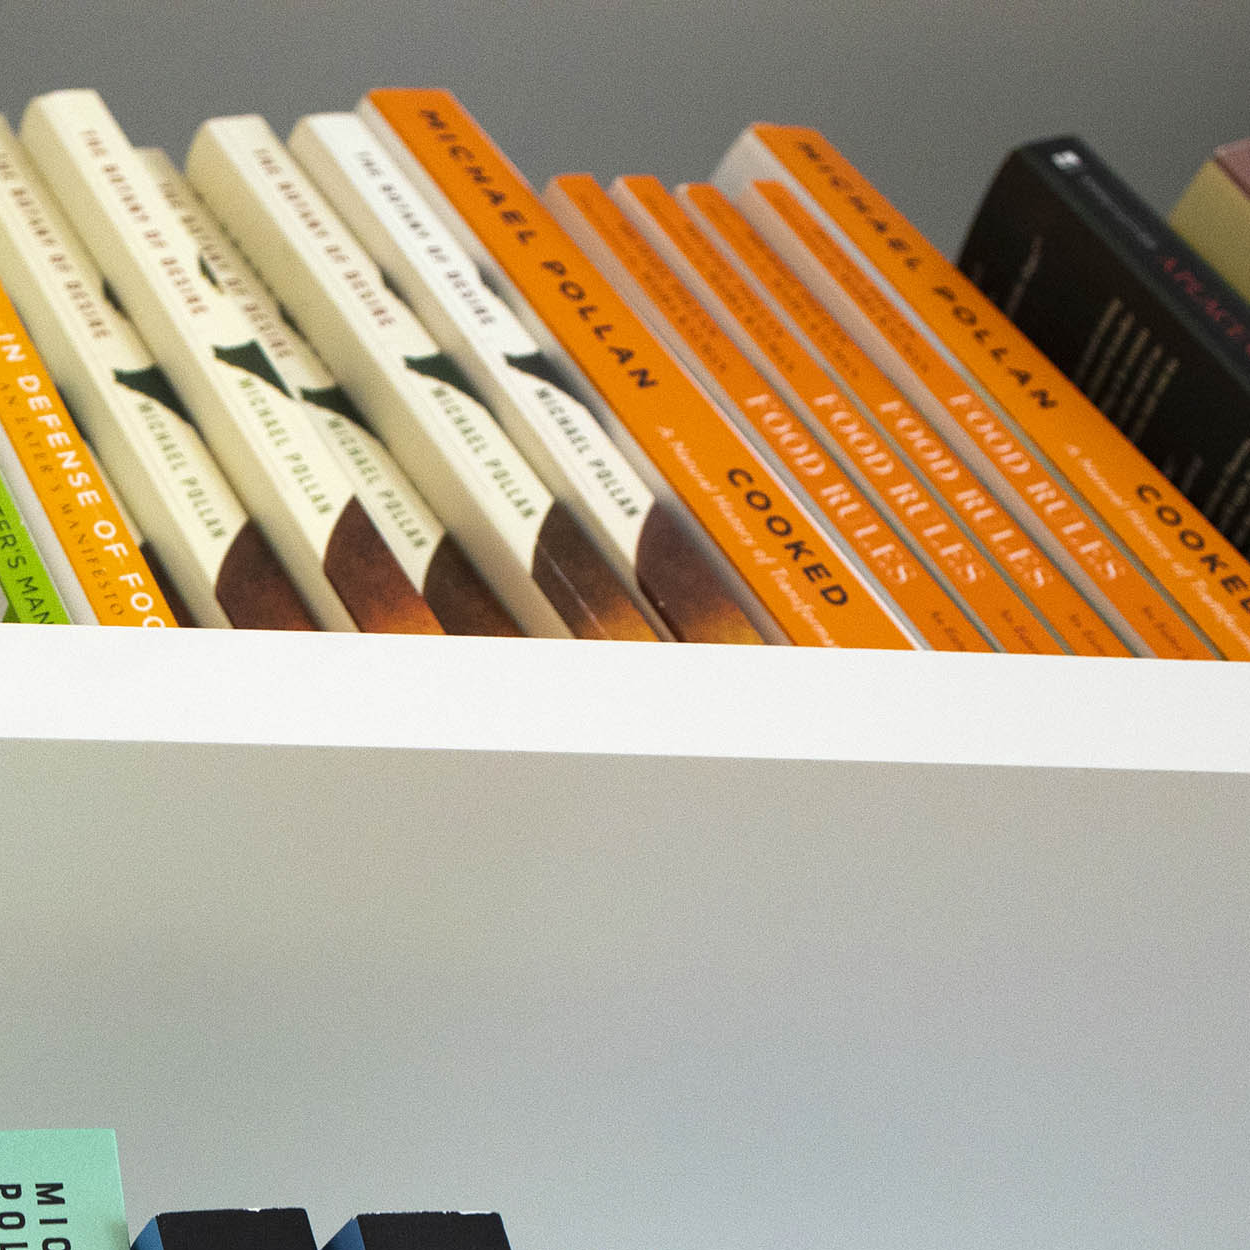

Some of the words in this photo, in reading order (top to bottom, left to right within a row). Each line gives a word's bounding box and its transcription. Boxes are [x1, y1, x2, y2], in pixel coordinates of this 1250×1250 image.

[418, 109, 537, 245] MICHAEL
[541, 259, 659, 389] POLLAN
[795, 141, 920, 270] MICHAEL
[932, 285, 1058, 409] POLLAN
[17, 375, 102, 507] DEFENSE
[93, 520, 128, 559] OF
[119, 572, 166, 629] FOO
[137, 401, 187, 472] MICHAEL
[181, 477, 227, 540] POLLAN
[238, 376, 291, 447] MICHAEL
[285, 452, 333, 515] POLLAN
[327, 416, 380, 486] MICHAEL
[379, 490, 429, 549] POLLAN
[432, 386, 488, 454] MICHAEL
[485, 458, 537, 519] POLLAN
[536, 387, 592, 454] MICHAEL
[588, 458, 642, 519] POLLAN
[745, 394, 826, 477] FOOD
[819, 483, 916, 584] RULES
[814, 394, 894, 476] FOOD
[889, 483, 988, 583] RULES
[879, 401, 960, 481] FOOD
[955, 488, 1045, 587] RULES
[949, 393, 1031, 475] FOOD
[1027, 481, 1126, 580] RULES
[17, 576, 54, 625] MAN
[61, 501, 125, 618] MANIFESTO
[727, 468, 848, 607] COOKED
